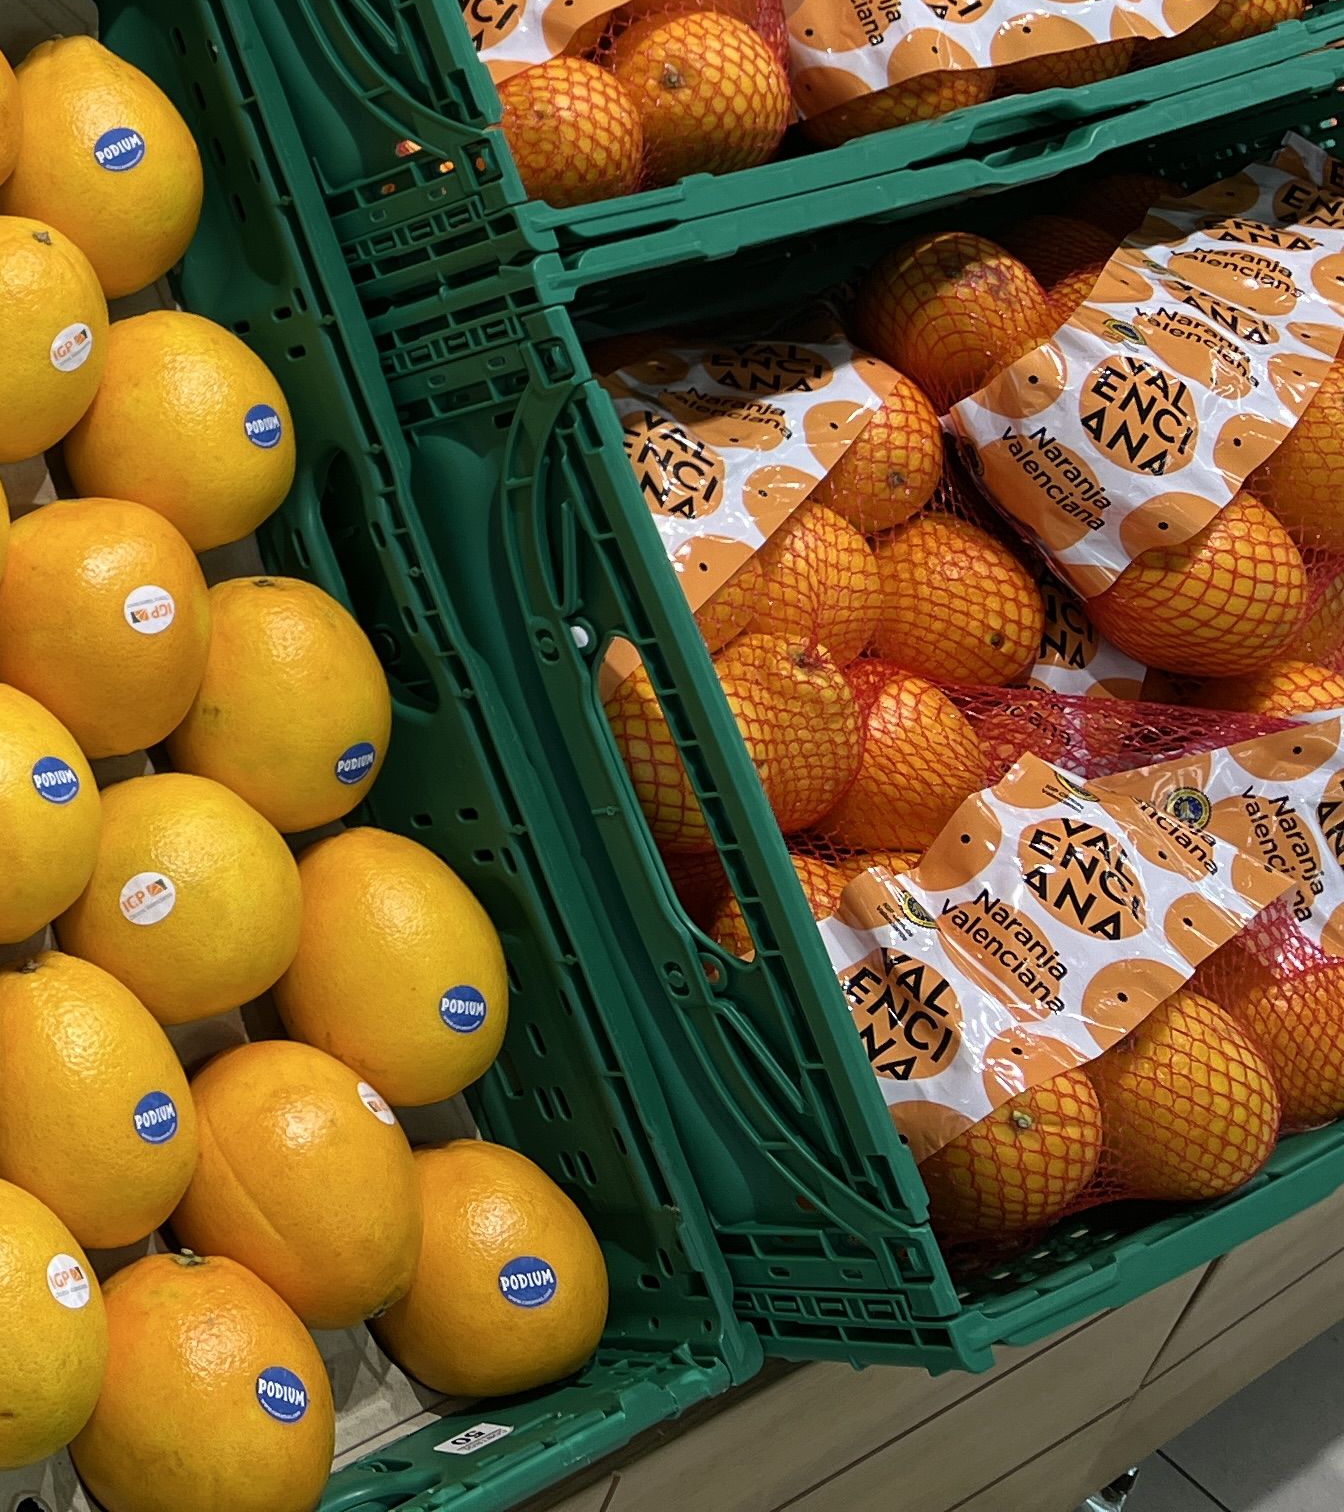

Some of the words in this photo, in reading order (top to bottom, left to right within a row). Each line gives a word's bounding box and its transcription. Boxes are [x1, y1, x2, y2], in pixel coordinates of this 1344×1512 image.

[94, 134, 141, 165] PODIUM
[713, 353, 823, 379] ENCI
[716, 370, 814, 394] ANA
[686, 387, 787, 418] Naranja
[1089, 363, 1193, 454] ENCI
[245, 416, 281, 436] PODIUM
[1081, 412, 1170, 476] ANA
[1000, 426, 1106, 532] valenciana
[1027, 426, 1112, 511] Naranja
[336, 751, 375, 774] PODIUM
[33, 769, 76, 789] PODIUM
[1268, 795, 1324, 896] Naranja
[1029, 828, 1140, 919] ENCI
[1024, 866, 1122, 941] ANA
[973, 888, 1068, 982] Naranja
[940, 898, 1066, 1014] valenciana
[440, 997, 485, 1016] PODIUM
[843, 966, 953, 1063] ENCI
[134, 1107, 175, 1128] PODIUM
[48, 1269, 70, 1289] IGP
[499, 1269, 554, 1293] PODIUM
[257, 1377, 305, 1407] PODIUM
